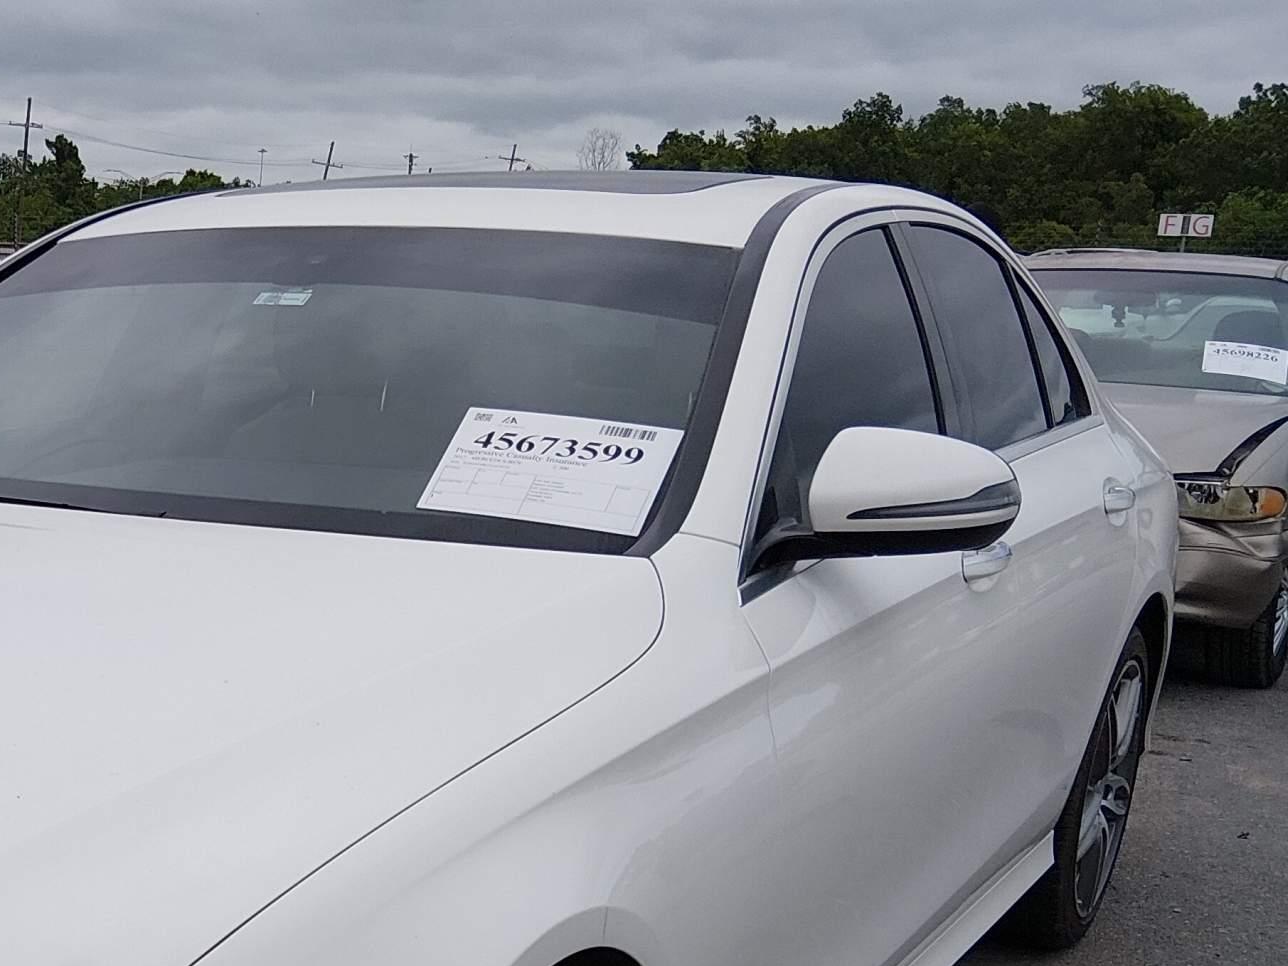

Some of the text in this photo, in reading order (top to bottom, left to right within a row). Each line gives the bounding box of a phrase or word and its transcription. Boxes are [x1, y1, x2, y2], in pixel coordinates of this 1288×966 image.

[1164, 215, 1210, 235] F G
[1212, 348, 1279, 362] 45698226
[473, 430, 645, 465] 45673599
